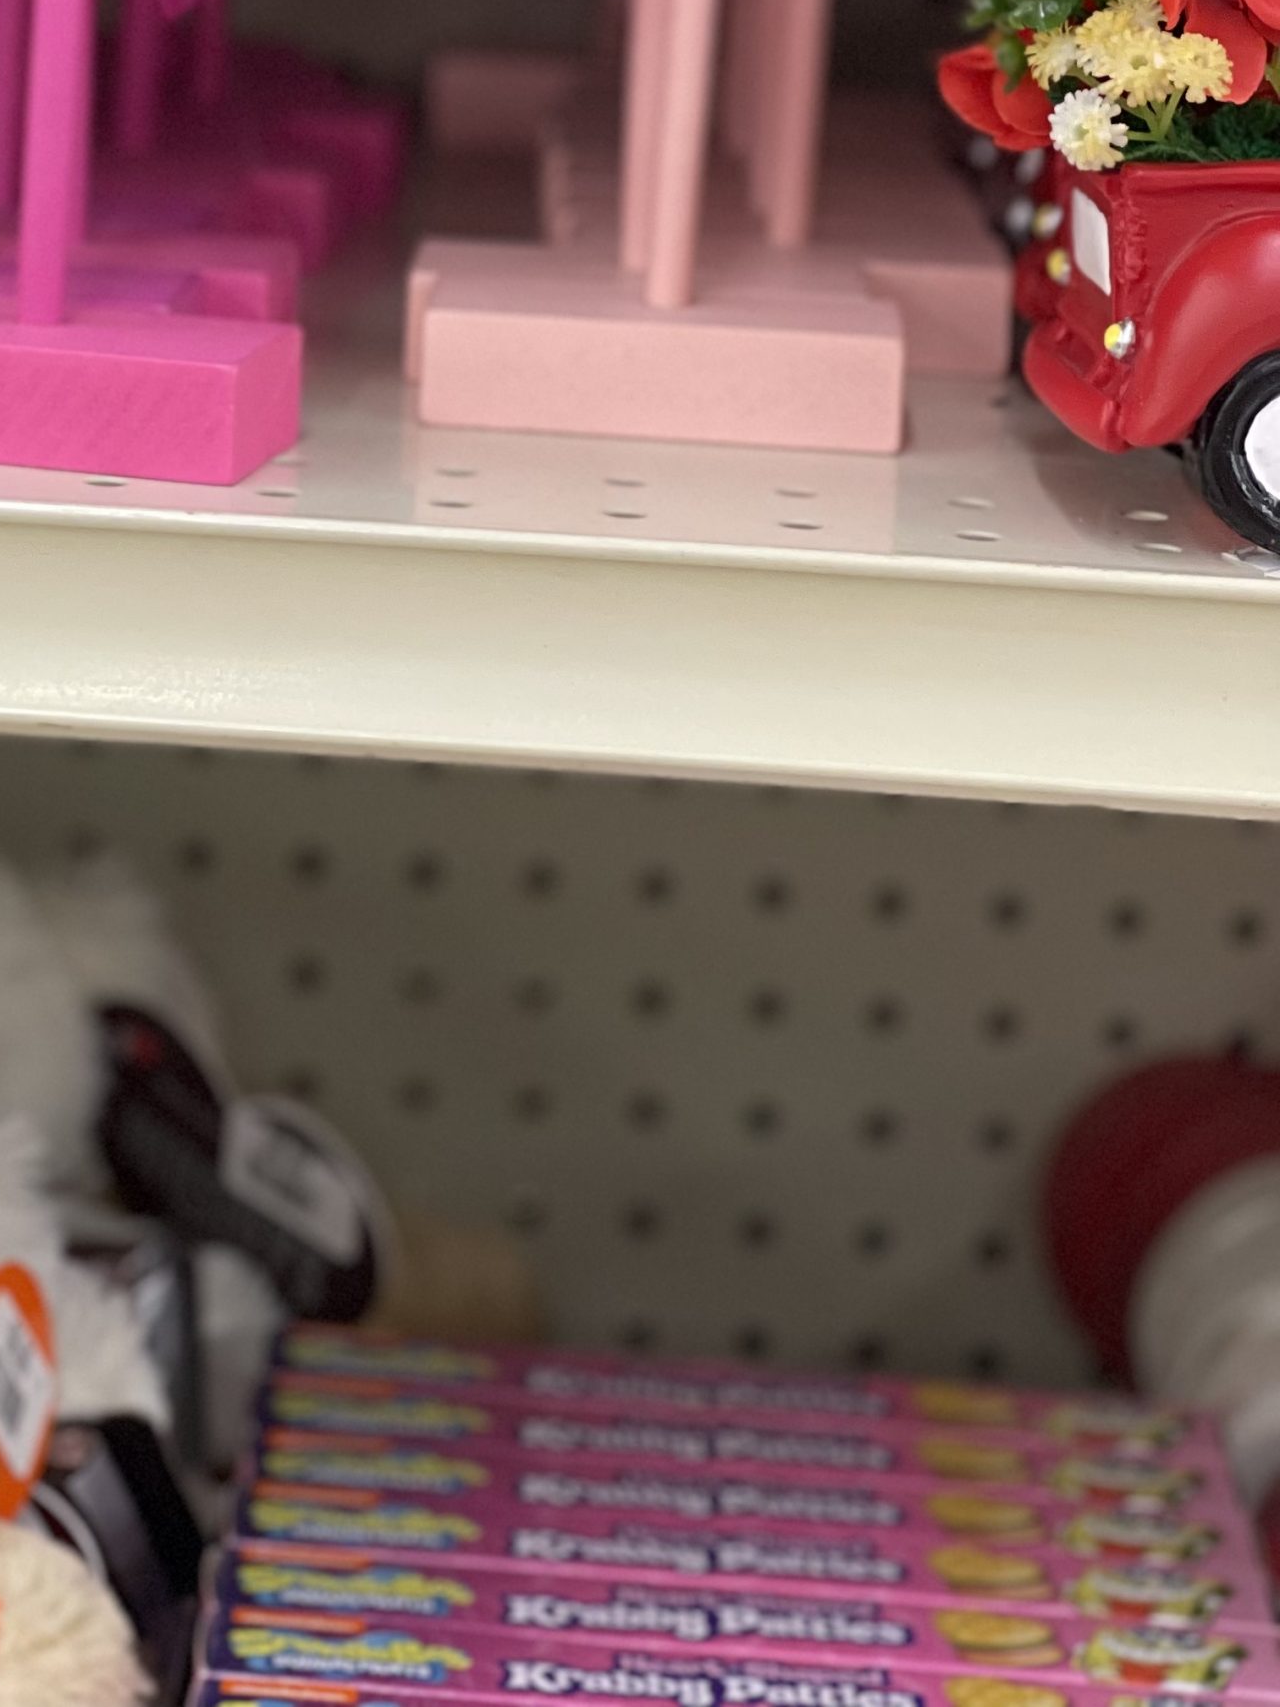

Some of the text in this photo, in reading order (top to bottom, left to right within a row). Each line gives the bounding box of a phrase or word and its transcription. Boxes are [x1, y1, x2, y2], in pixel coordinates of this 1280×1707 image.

[507, 1595, 711, 1641] Krabby
[722, 1603, 911, 1644] Patties
[505, 1661, 716, 1707] Krabby
